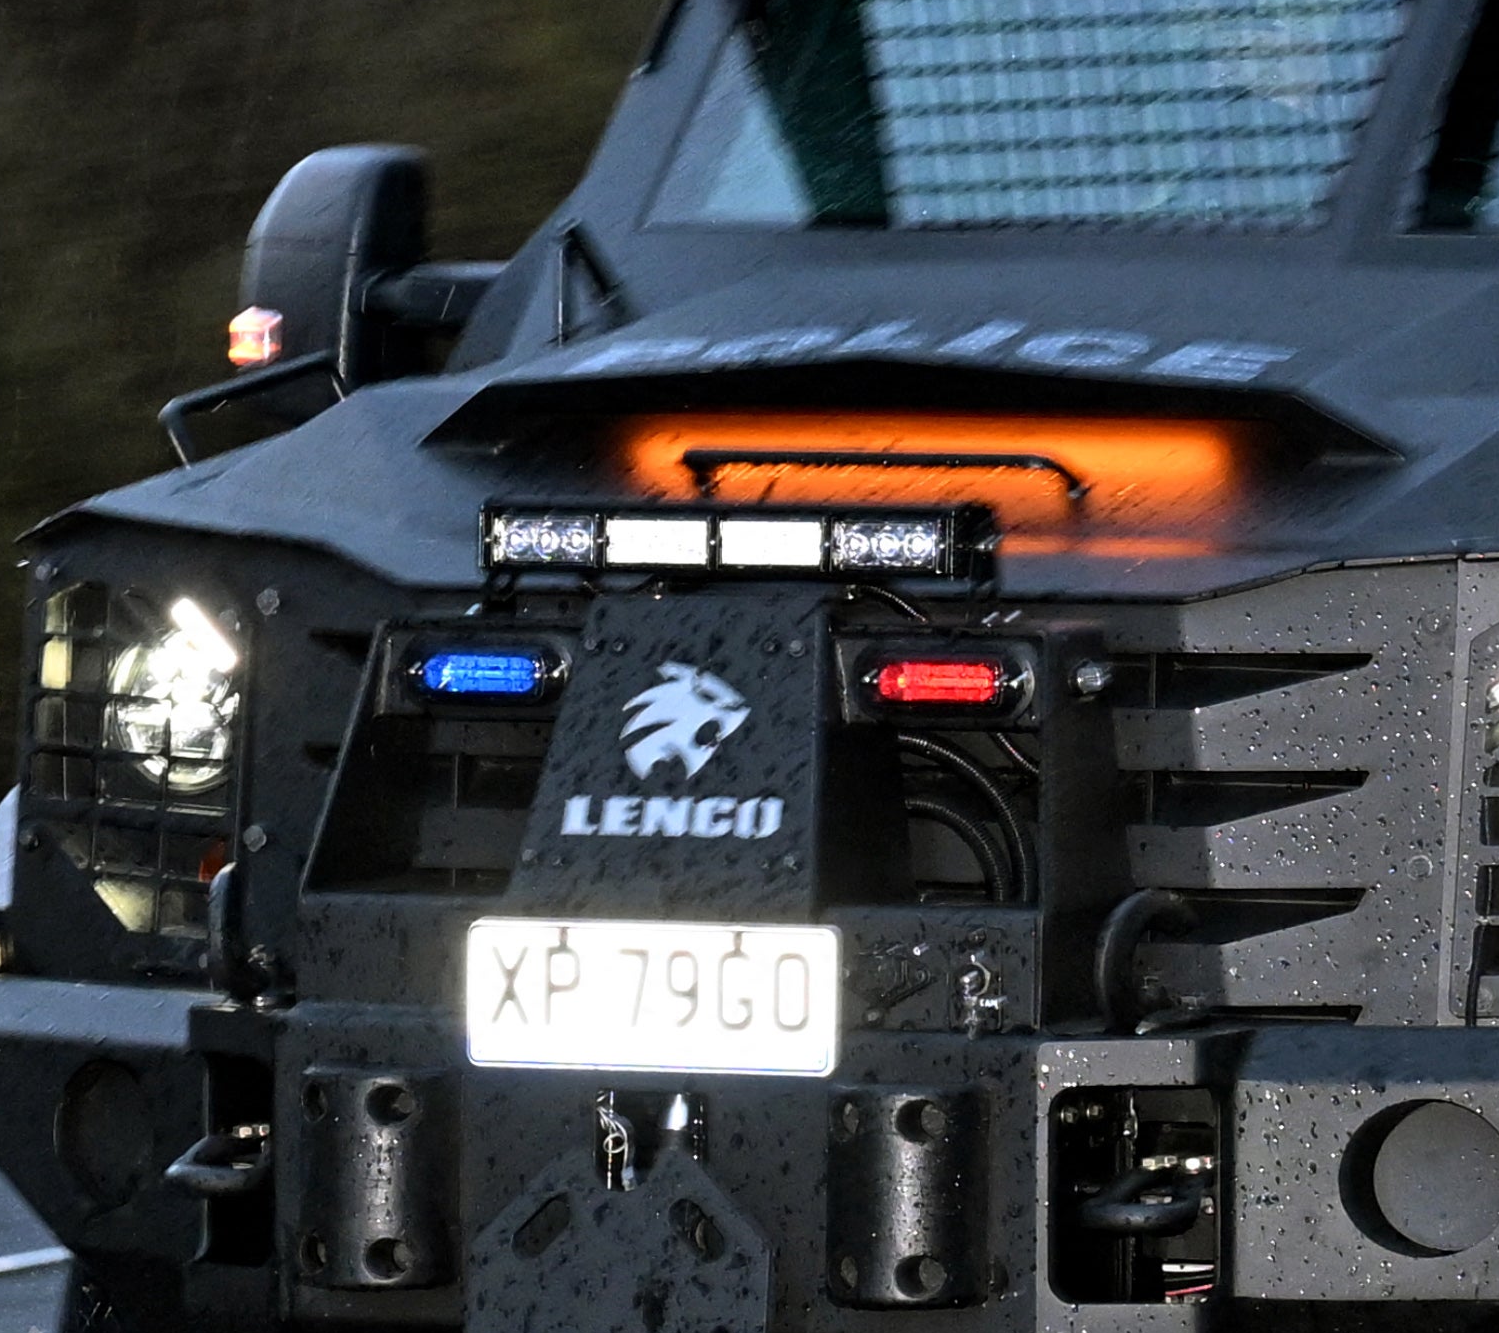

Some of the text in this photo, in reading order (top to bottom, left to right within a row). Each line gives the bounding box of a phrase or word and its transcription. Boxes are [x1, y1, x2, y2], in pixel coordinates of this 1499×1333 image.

[564, 318, 1299, 382] POLICE
[561, 795, 785, 839] LENCO
[492, 946, 580, 1025] XP
